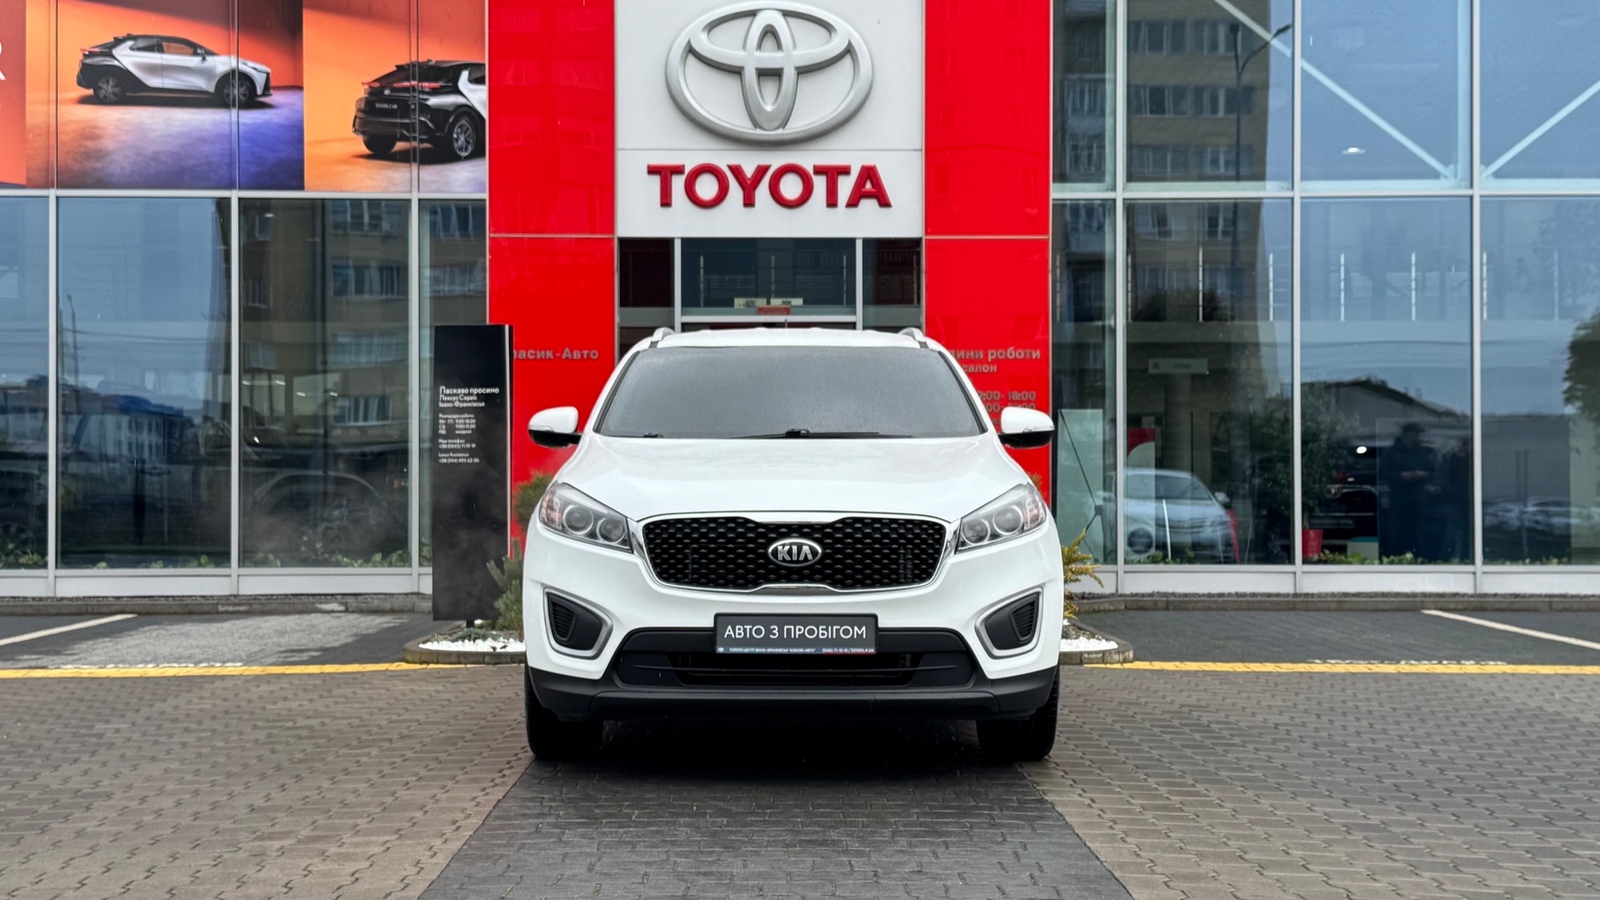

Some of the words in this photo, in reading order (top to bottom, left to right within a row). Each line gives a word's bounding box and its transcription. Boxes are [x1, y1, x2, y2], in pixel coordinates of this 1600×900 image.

[647, 163, 892, 209] TOYOTA
[988, 346, 1041, 362] роботи
[470, 387, 500, 395] просимо
[777, 545, 813, 561] KIA
[724, 625, 765, 639] АВТО
[769, 625, 779, 639] З
[784, 625, 866, 639] ПРОБІГОМ
